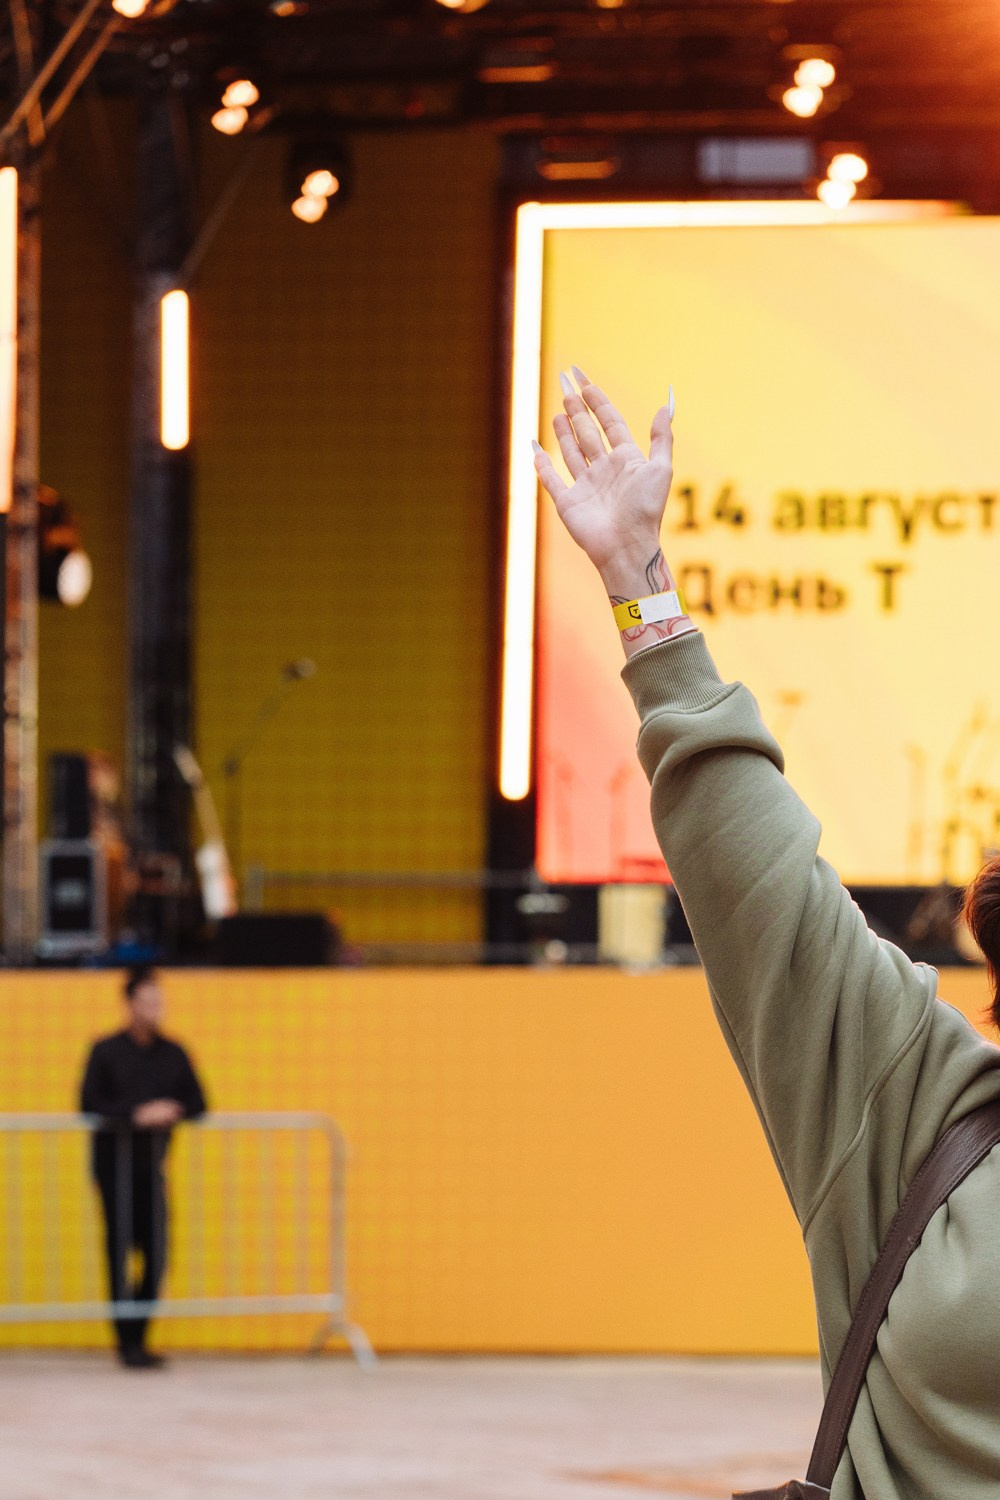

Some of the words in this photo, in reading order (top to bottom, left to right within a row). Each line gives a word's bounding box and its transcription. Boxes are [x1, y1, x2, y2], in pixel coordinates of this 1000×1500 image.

[676, 483, 745, 529] 14
[680, 562, 847, 617] День
[871, 560, 907, 610] Т
